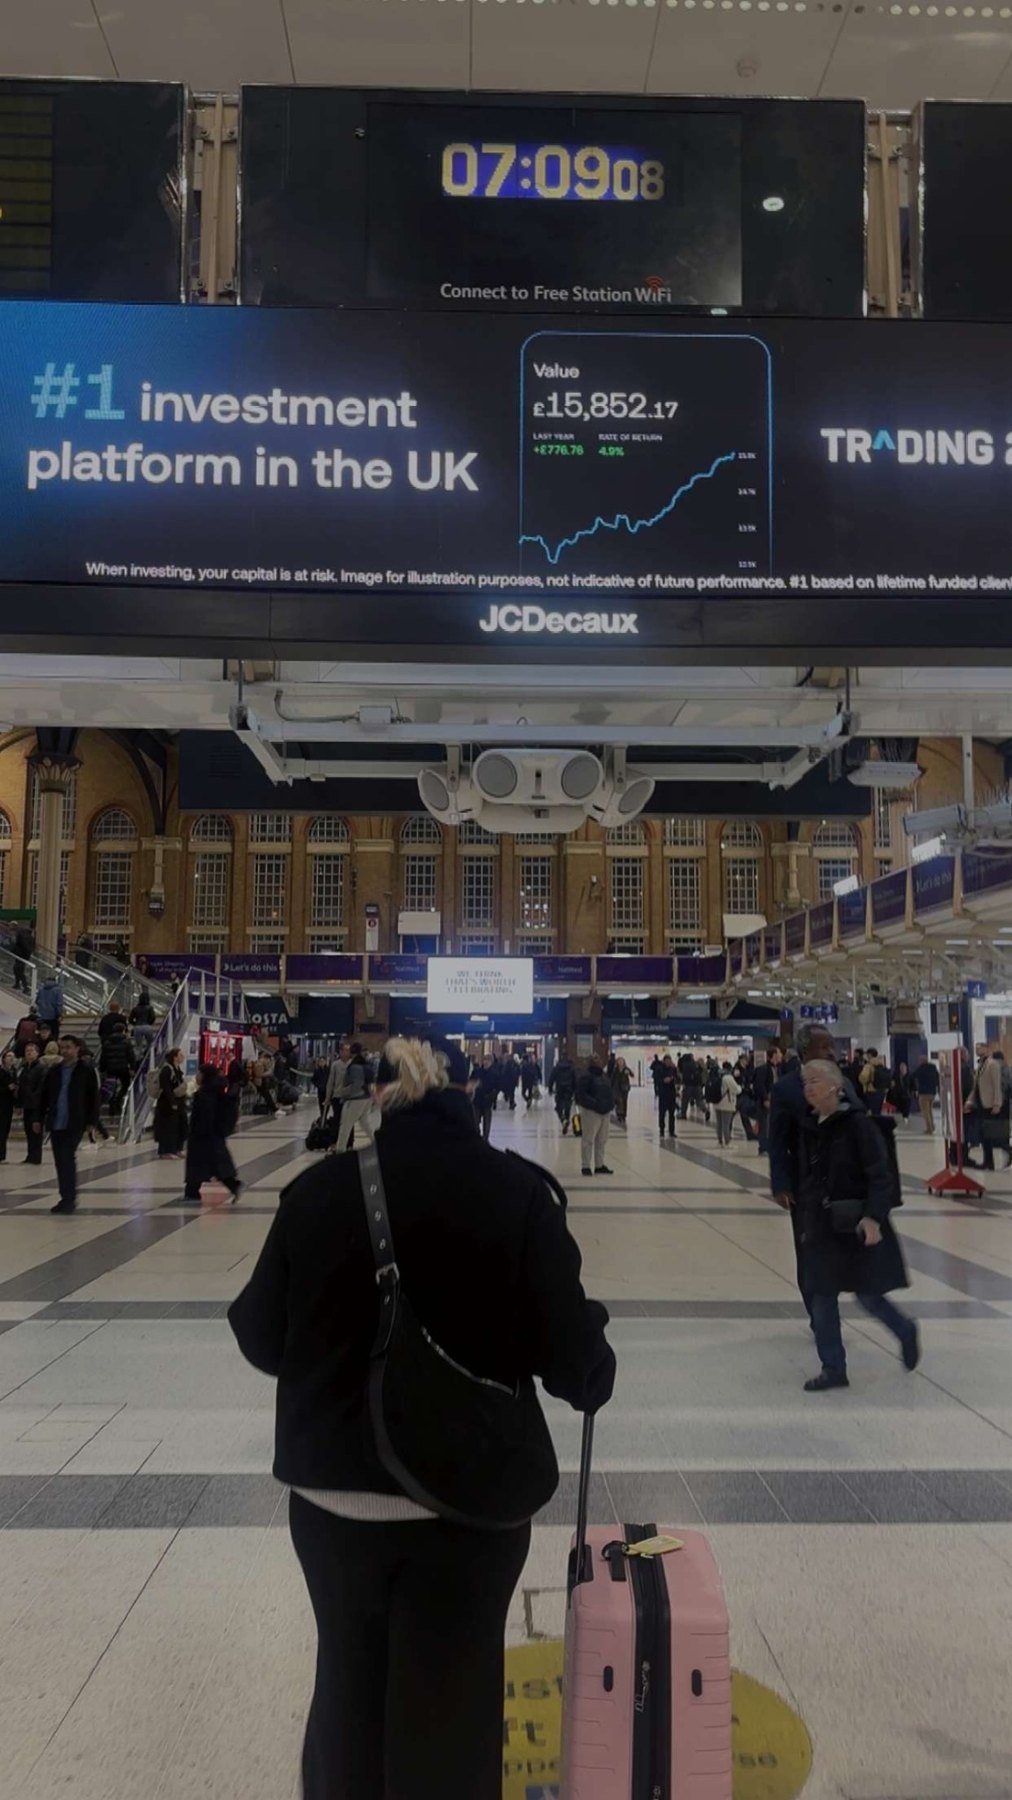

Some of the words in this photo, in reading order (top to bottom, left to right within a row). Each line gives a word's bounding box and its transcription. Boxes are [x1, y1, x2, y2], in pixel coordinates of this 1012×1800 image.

[440, 284, 506, 300] Connect
[511, 286, 528, 300] to
[534, 286, 569, 300] Free
[572, 287, 631, 302] Station
[634, 288, 672, 303] WiFi
[532, 362, 580, 379] Value
[31, 363, 125, 420] #1
[141, 382, 418, 427] investment
[533, 392, 679, 421] £15,852.17
[532, 433, 552, 441] LAST
[554, 433, 575, 441] YEAR
[598, 433, 618, 441] RATE
[632, 433, 663, 442] RETURN
[27, 441, 241, 490] platform
[255, 446, 298, 487] in
[312, 449, 393, 489] the
[408, 451, 480, 492] UK
[86, 563, 127, 577] When
[130, 564, 195, 581] investing,
[198, 568, 228, 581] your
[232, 568, 277, 582] capital
[280, 569, 291, 580] is
[295, 569, 308, 582] at
[311, 569, 338, 583] risk.
[341, 570, 383, 586] Image
[386, 570, 405, 583] for
[408, 571, 476, 585] illustration
[478, 573, 544, 588] purposes,
[546, 575, 570, 587] not
[572, 574, 635, 587] indicative
[638, 574, 653, 587] of
[654, 574, 694, 588] future
[697, 574, 787, 591] performance.
[789, 575, 808, 589] #1
[811, 574, 854, 589] based
[856, 578, 875, 589] on
[877, 574, 926, 589] lifetime
[928, 574, 978, 589] funded
[479, 605, 639, 633] JCDecaux
[229, 963, 249, 971] Let's
[251, 963, 262, 971] do
[263, 963, 278, 971] this
[249, 1012, 288, 1024] OSTA
